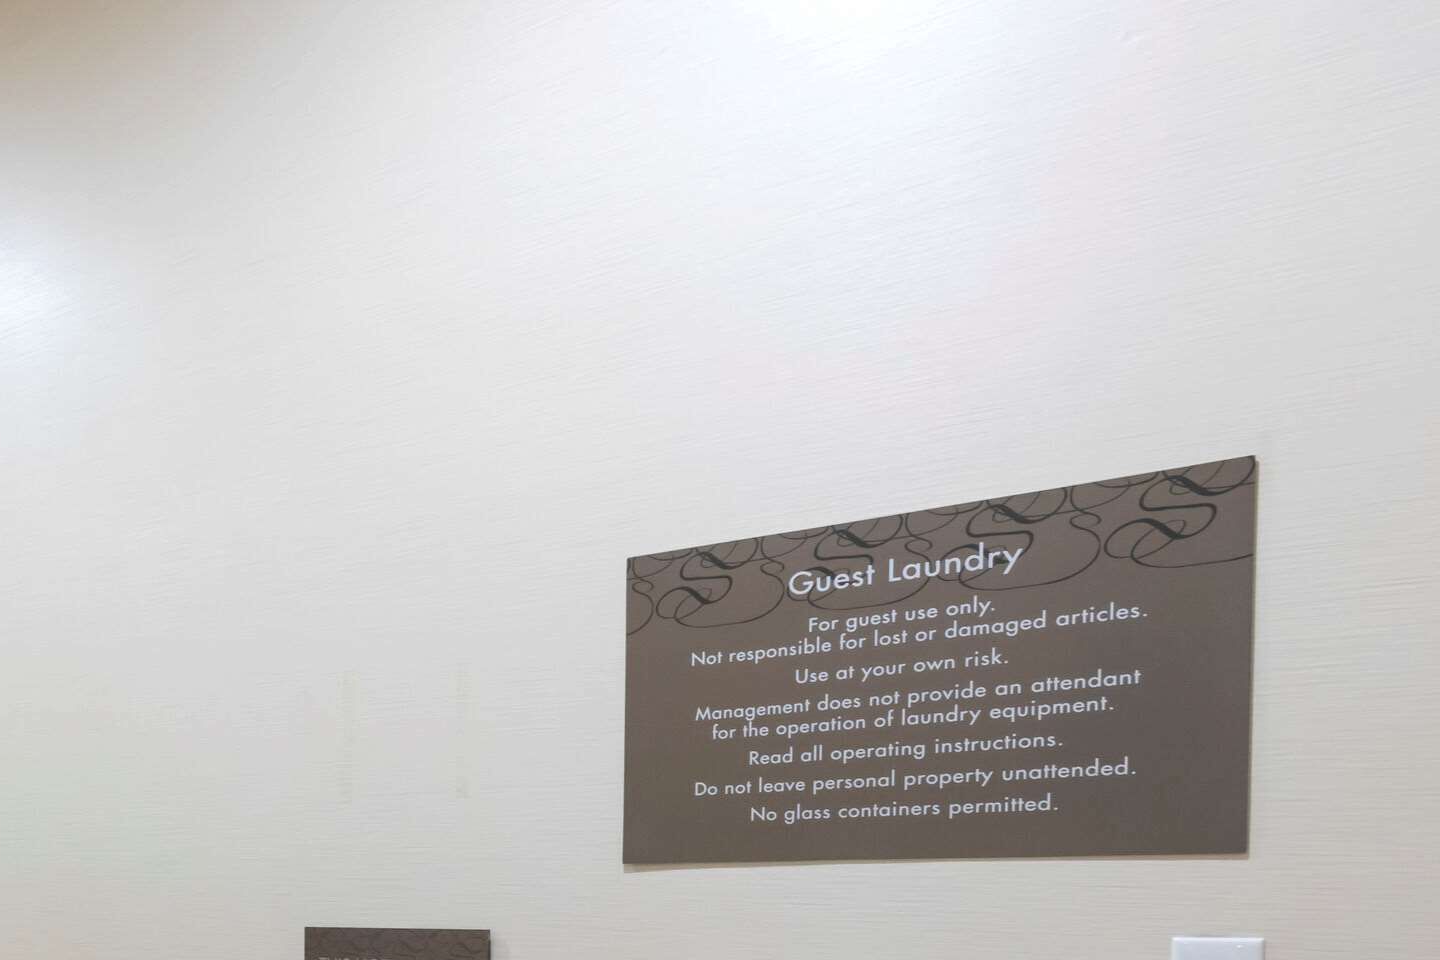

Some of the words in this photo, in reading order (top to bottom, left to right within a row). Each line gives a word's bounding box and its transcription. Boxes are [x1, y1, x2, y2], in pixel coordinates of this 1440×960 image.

[788, 565, 875, 595] Guest
[888, 541, 1023, 582] Laundry
[691, 651, 723, 666] Not
[729, 636, 831, 664] responsible
[840, 633, 866, 650] for
[874, 629, 908, 646] lost
[915, 630, 937, 642] or
[945, 610, 1046, 638] damaged
[1056, 601, 1147, 626] articles.
[809, 617, 839, 632] For
[846, 609, 897, 632] guest
[905, 608, 938, 621] use
[946, 595, 995, 617] only.
[795, 668, 829, 684] Use
[836, 666, 855, 680] at
[861, 663, 906, 682] your
[913, 658, 955, 672] own
[965, 647, 1008, 667] risk.
[695, 699, 811, 721] Management
[817, 693, 861, 711] does
[869, 691, 900, 706] not
[908, 680, 986, 708] provide
[995, 683, 1021, 696] an
[1031, 668, 1141, 693] attendant
[712, 723, 736, 740] for
[743, 725, 769, 737] the
[776, 716, 866, 739] operation
[874, 709, 894, 728] of
[901, 704, 981, 726] laundry
[989, 696, 1114, 722] equipment.
[749, 746, 793, 765] Read
[800, 744, 823, 762] all
[830, 741, 925, 764] operating
[935, 733, 1063, 754] instructions.
[694, 782, 718, 796] Do
[725, 781, 752, 794] not
[759, 777, 806, 793] leave
[813, 769, 895, 795] personal
[904, 769, 993, 790] property
[1002, 756, 1136, 781] unattended.
[751, 807, 777, 821] No
[784, 803, 830, 824] glass
[838, 801, 940, 818] containers
[949, 792, 1058, 819] permitted.
